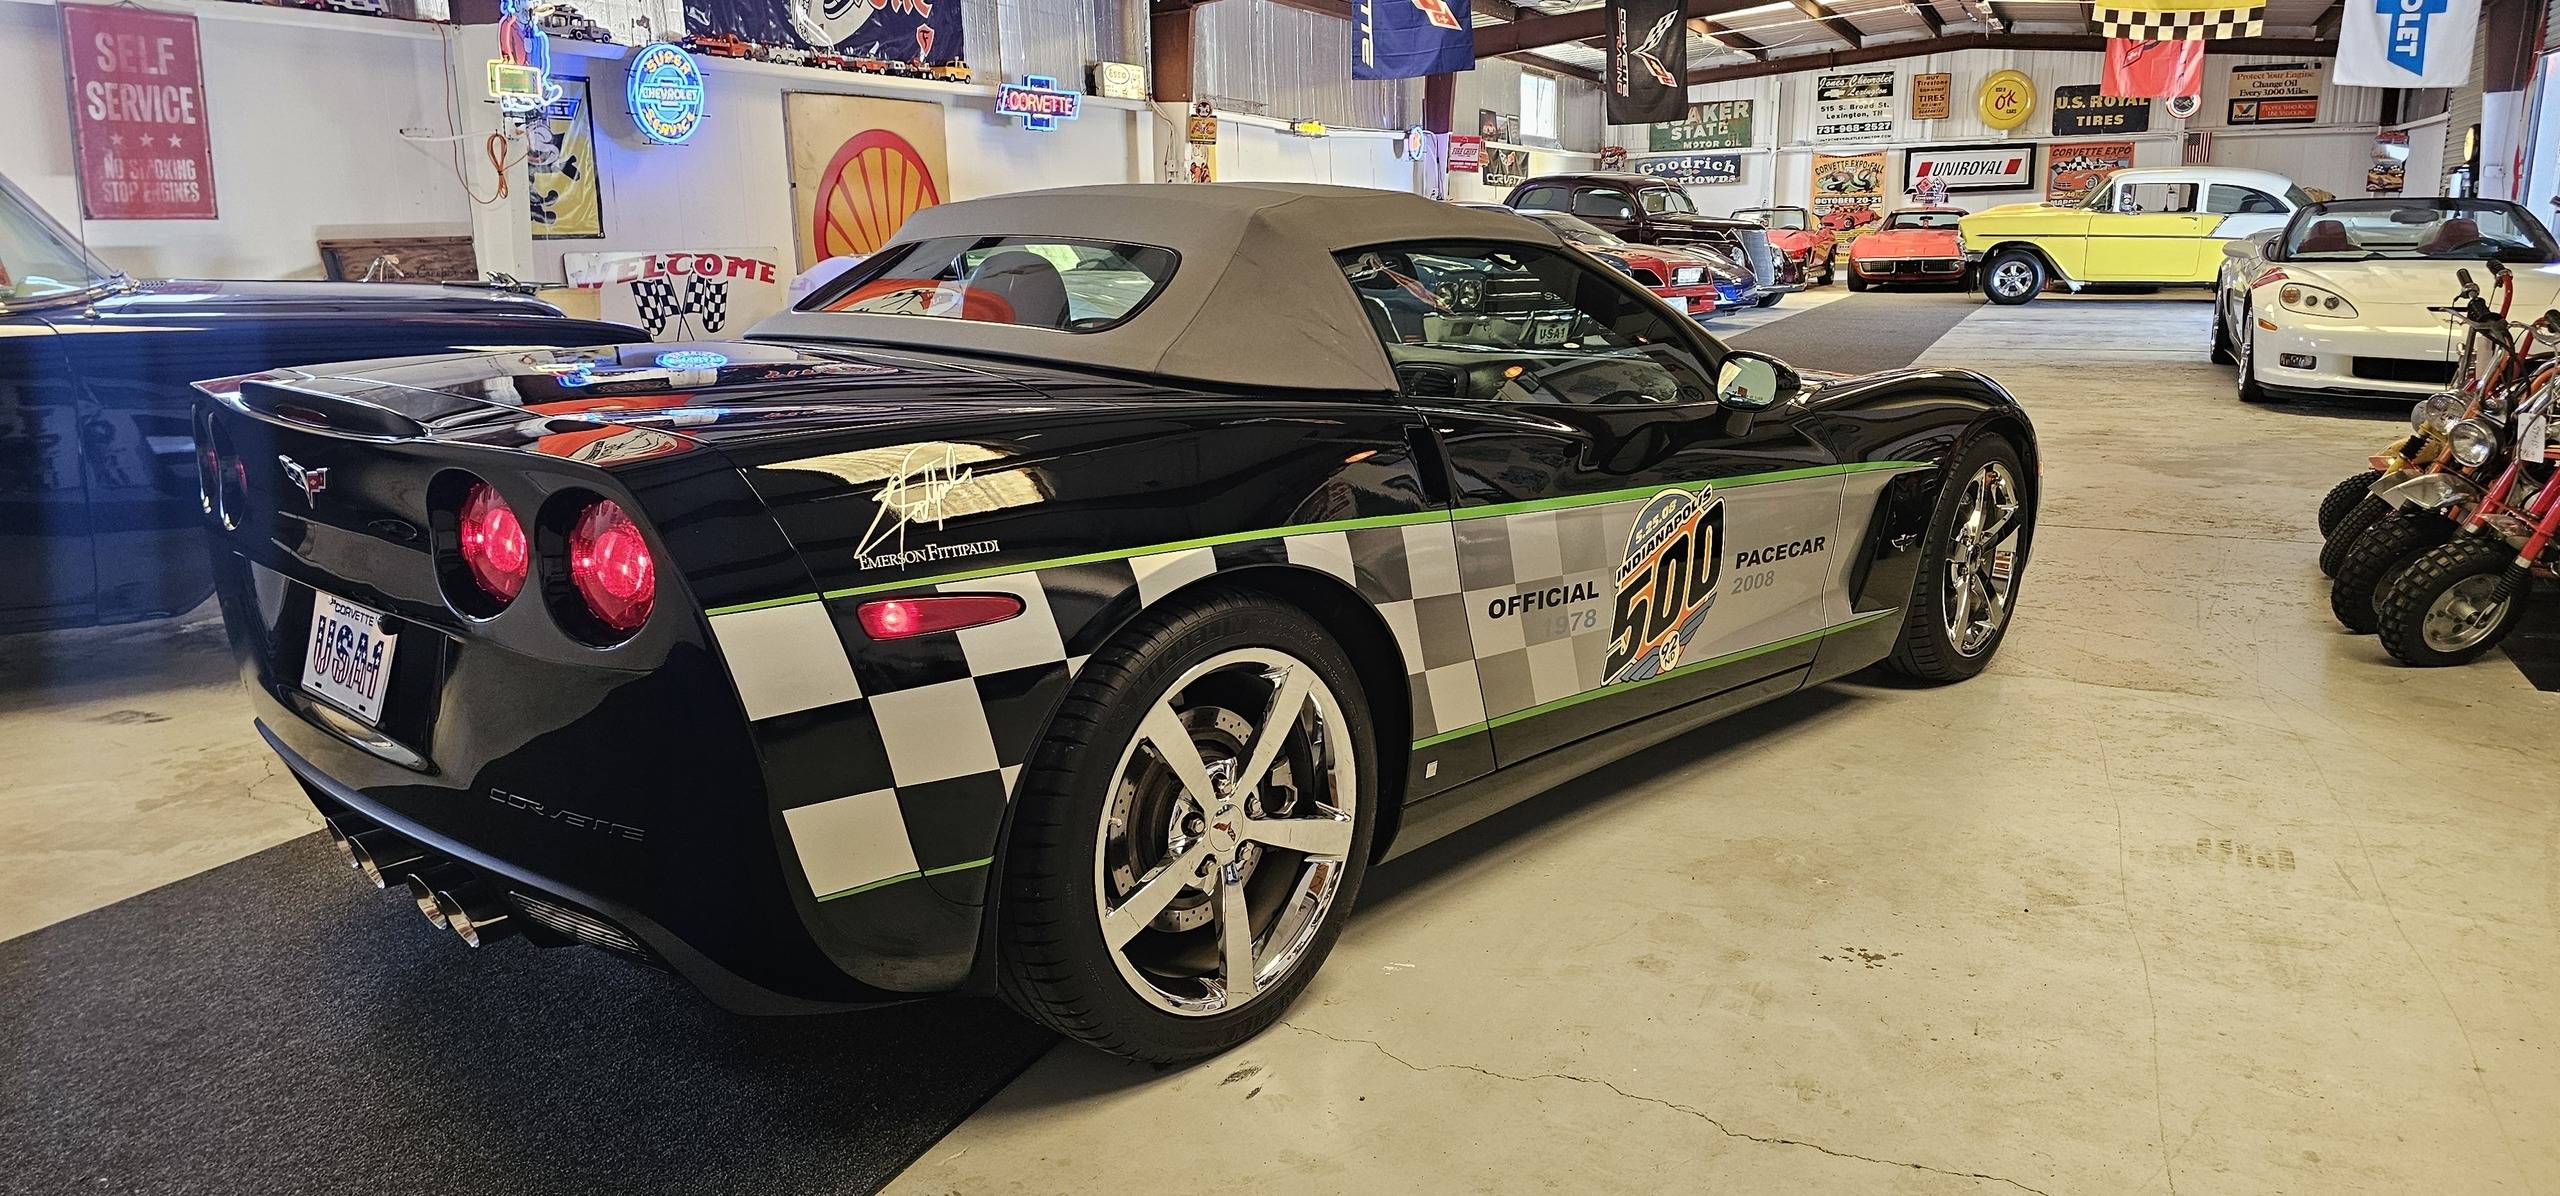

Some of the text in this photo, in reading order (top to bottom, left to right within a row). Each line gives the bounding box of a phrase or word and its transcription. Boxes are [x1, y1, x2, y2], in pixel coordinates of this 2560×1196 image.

[95, 32, 175, 76] SELF
[645, 50, 692, 75] SUPER
[1620, 8, 1630, 98] CORVETTE
[1849, 74, 1894, 88] Chevrolet
[2236, 72, 2265, 81] Protect
[2285, 69, 2317, 79] Engine
[2252, 79, 2298, 89] Change Oil
[86, 80, 196, 125] SERVICE
[641, 87, 698, 101] CHEVROLET
[1008, 91, 1075, 115] CORVETTE
[1918, 95, 1945, 103] TIRES
[1994, 89, 2019, 111] OK
[2056, 95, 2149, 109] U.S. ROYAL
[2239, 87, 2309, 98] Every 3,000 Miles
[1820, 105, 1835, 113] 515
[1849, 102, 1875, 111] Broad
[1878, 101, 1890, 109] St.
[1826, 110, 1870, 120] Lexington,
[1671, 119, 1729, 141] STATE
[1817, 122, 1891, 134] 731-968-2527
[2076, 114, 2125, 127] TIRES
[1683, 138, 1742, 149] MOTOR OIL
[2052, 146, 2132, 157] CORVETTE EXPO
[103, 154, 125, 181] NO
[1639, 157, 1736, 176] Goodrich
[1815, 160, 1849, 176] CORVETTE
[1932, 160, 2003, 177] UNIROYAL
[102, 181, 139, 203] STOP
[1815, 196, 1882, 205] OCTOBER 20-21
[572, 253, 776, 290] WELCOME
[1635, 499, 1678, 546] 5.25.08
[1616, 484, 1713, 584] INDIANAPOLIS
[859, 540, 1001, 571] EMERSON FITTIPALDI
[1735, 536, 1826, 570] PACECAR
[1602, 497, 1726, 687] 500
[1731, 570, 1776, 596] 2008
[1488, 581, 1600, 619] OFFICIAL
[335, 602, 375, 627] CORVETTE
[1661, 633, 1680, 659] 92
[490, 788, 645, 842] CORVETTE
